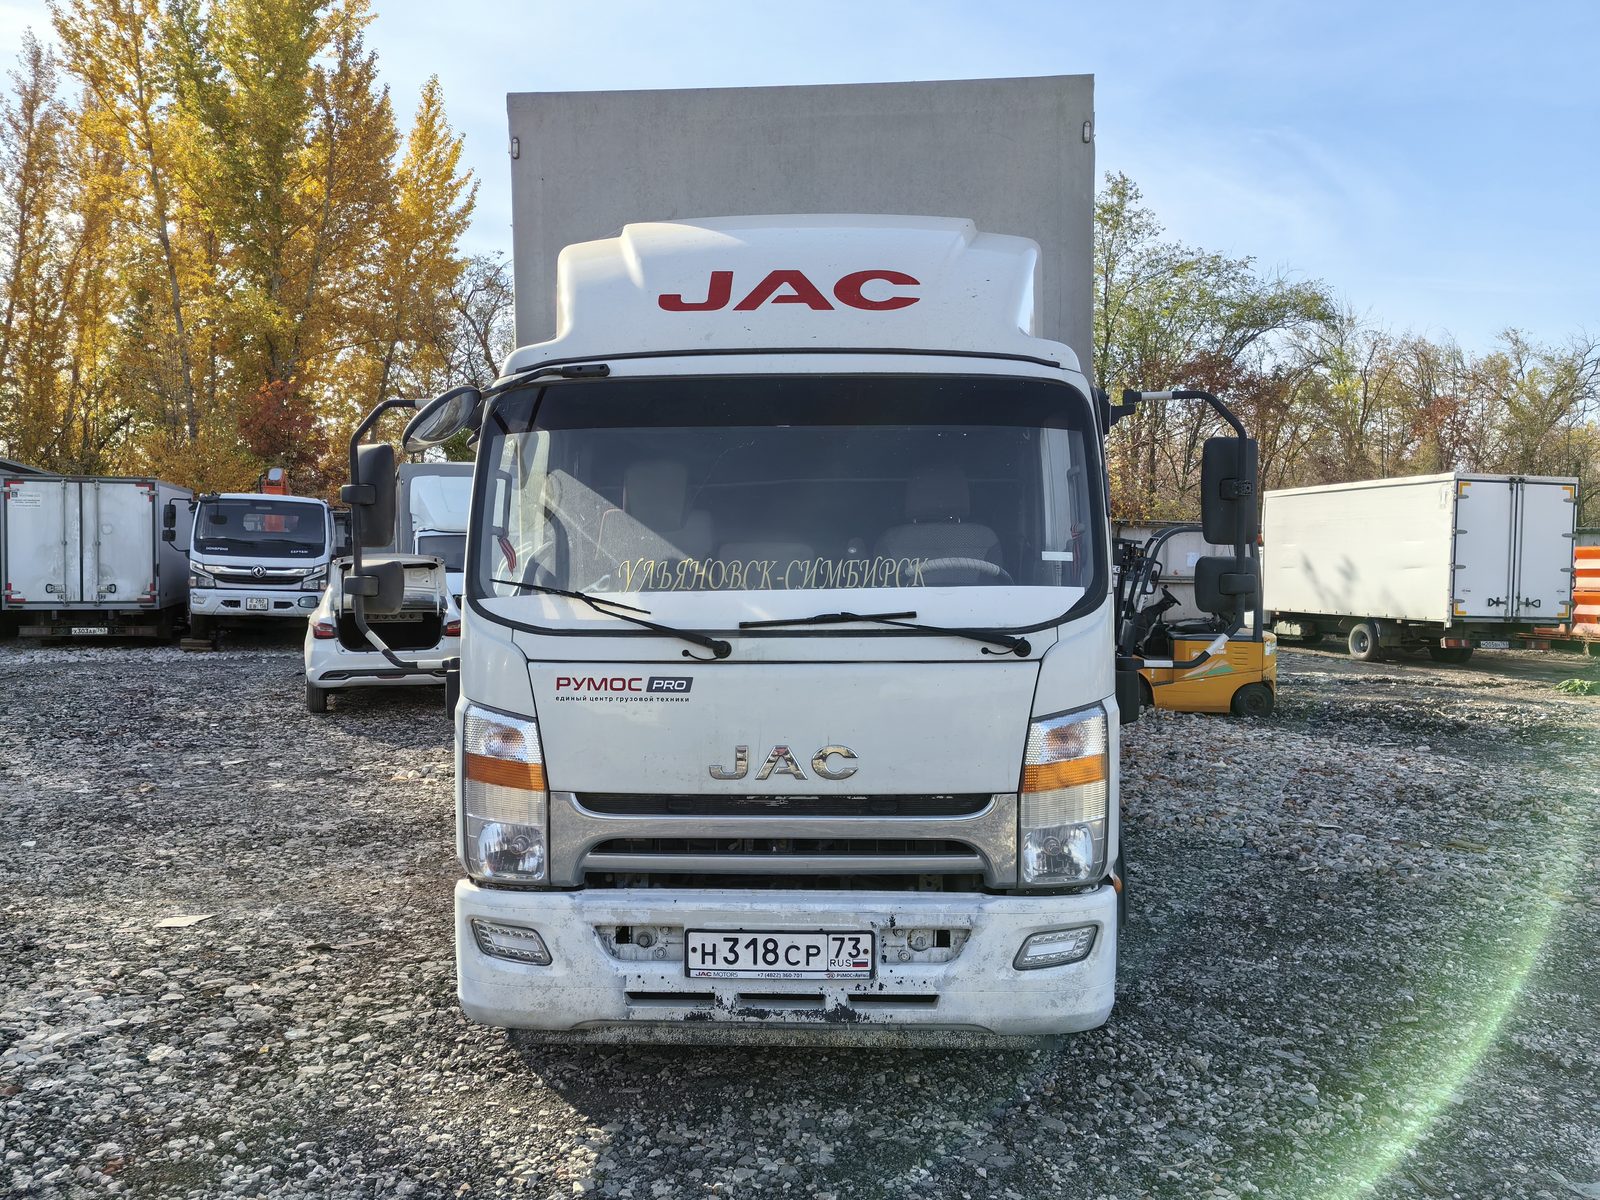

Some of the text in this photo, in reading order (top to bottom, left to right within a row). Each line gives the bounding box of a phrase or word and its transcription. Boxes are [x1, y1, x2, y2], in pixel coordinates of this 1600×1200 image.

[658, 269, 921, 312] JAC
[617, 556, 929, 593] УЛЬЯНОВСК-СИМБИРСК
[556, 677, 687, 692] РУМОС PRO
[708, 744, 860, 781] JAC
[700, 937, 862, 967] Н318СР 73
[829, 958, 852, 967] RUS
